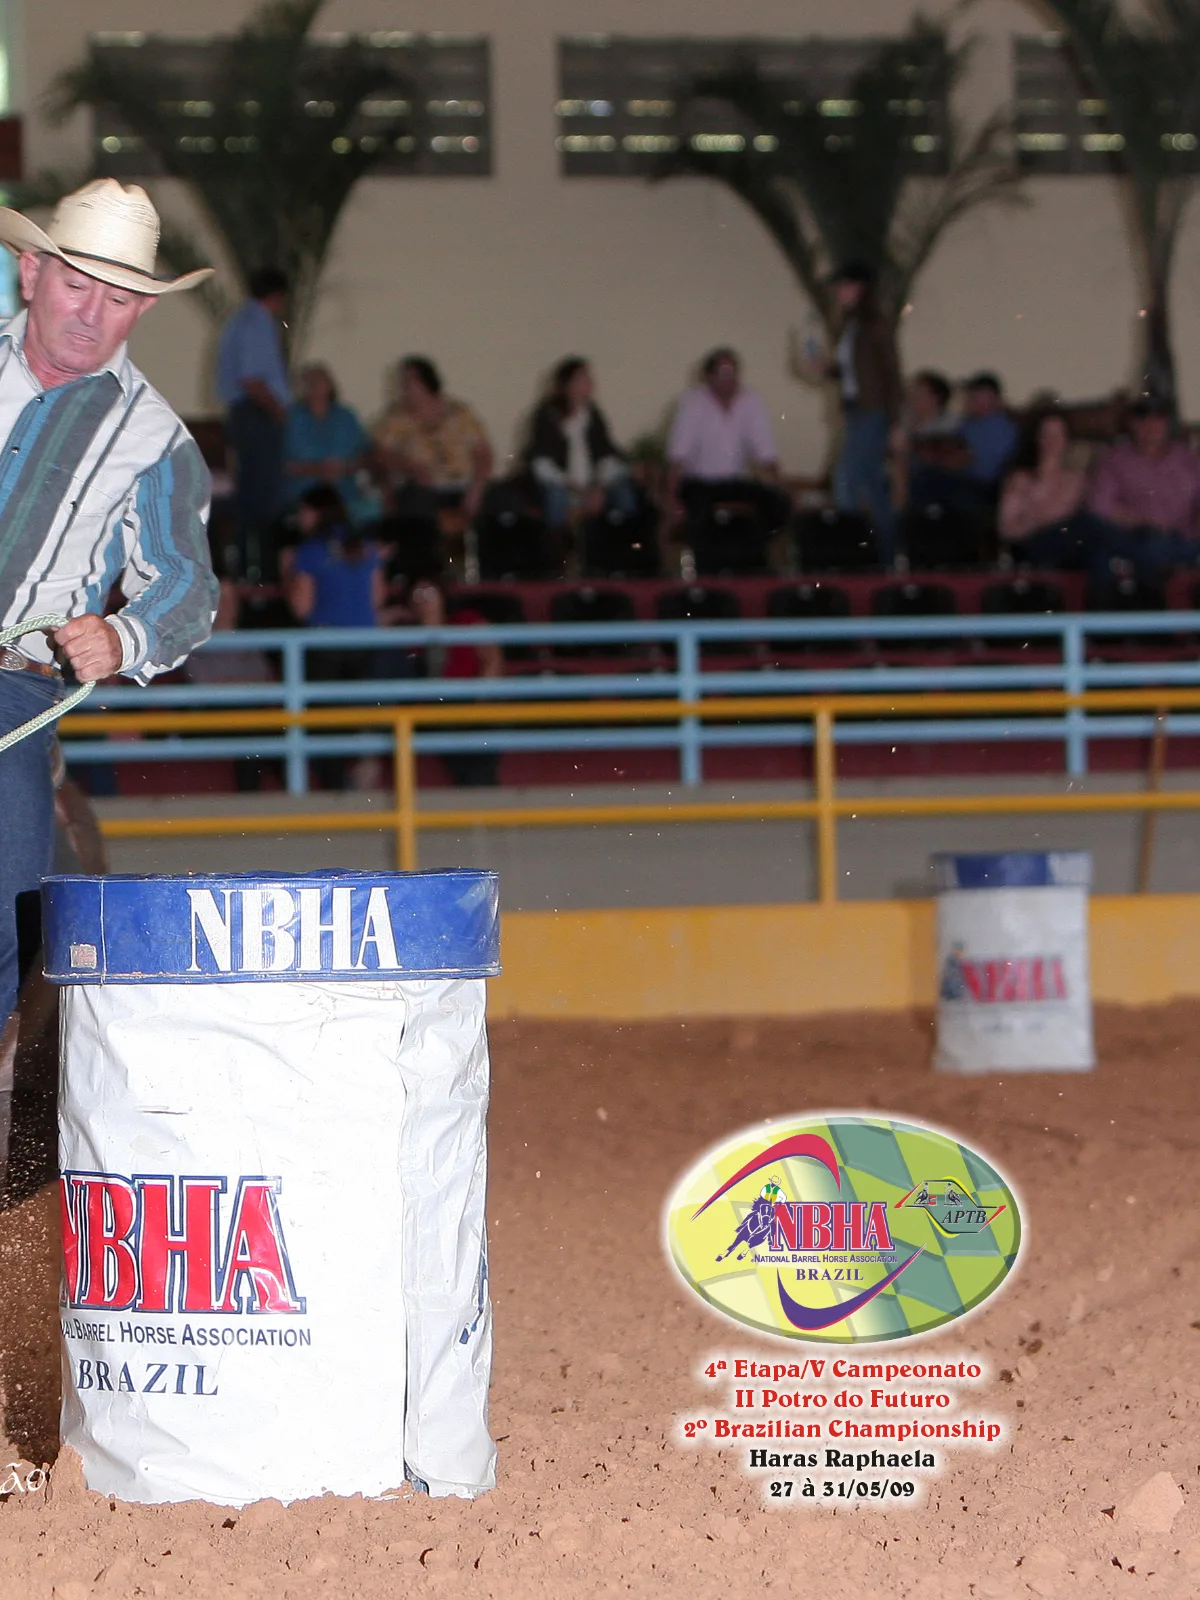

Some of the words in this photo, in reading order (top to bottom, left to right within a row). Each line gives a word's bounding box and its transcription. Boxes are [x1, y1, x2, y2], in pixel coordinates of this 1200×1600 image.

[186, 886, 402, 972] NBHA
[73, 1318, 115, 1342] BARREL
[119, 1320, 178, 1345] HORSE
[181, 1323, 312, 1347] ASSOCIATION
[76, 1358, 219, 1396] BRAZIL
